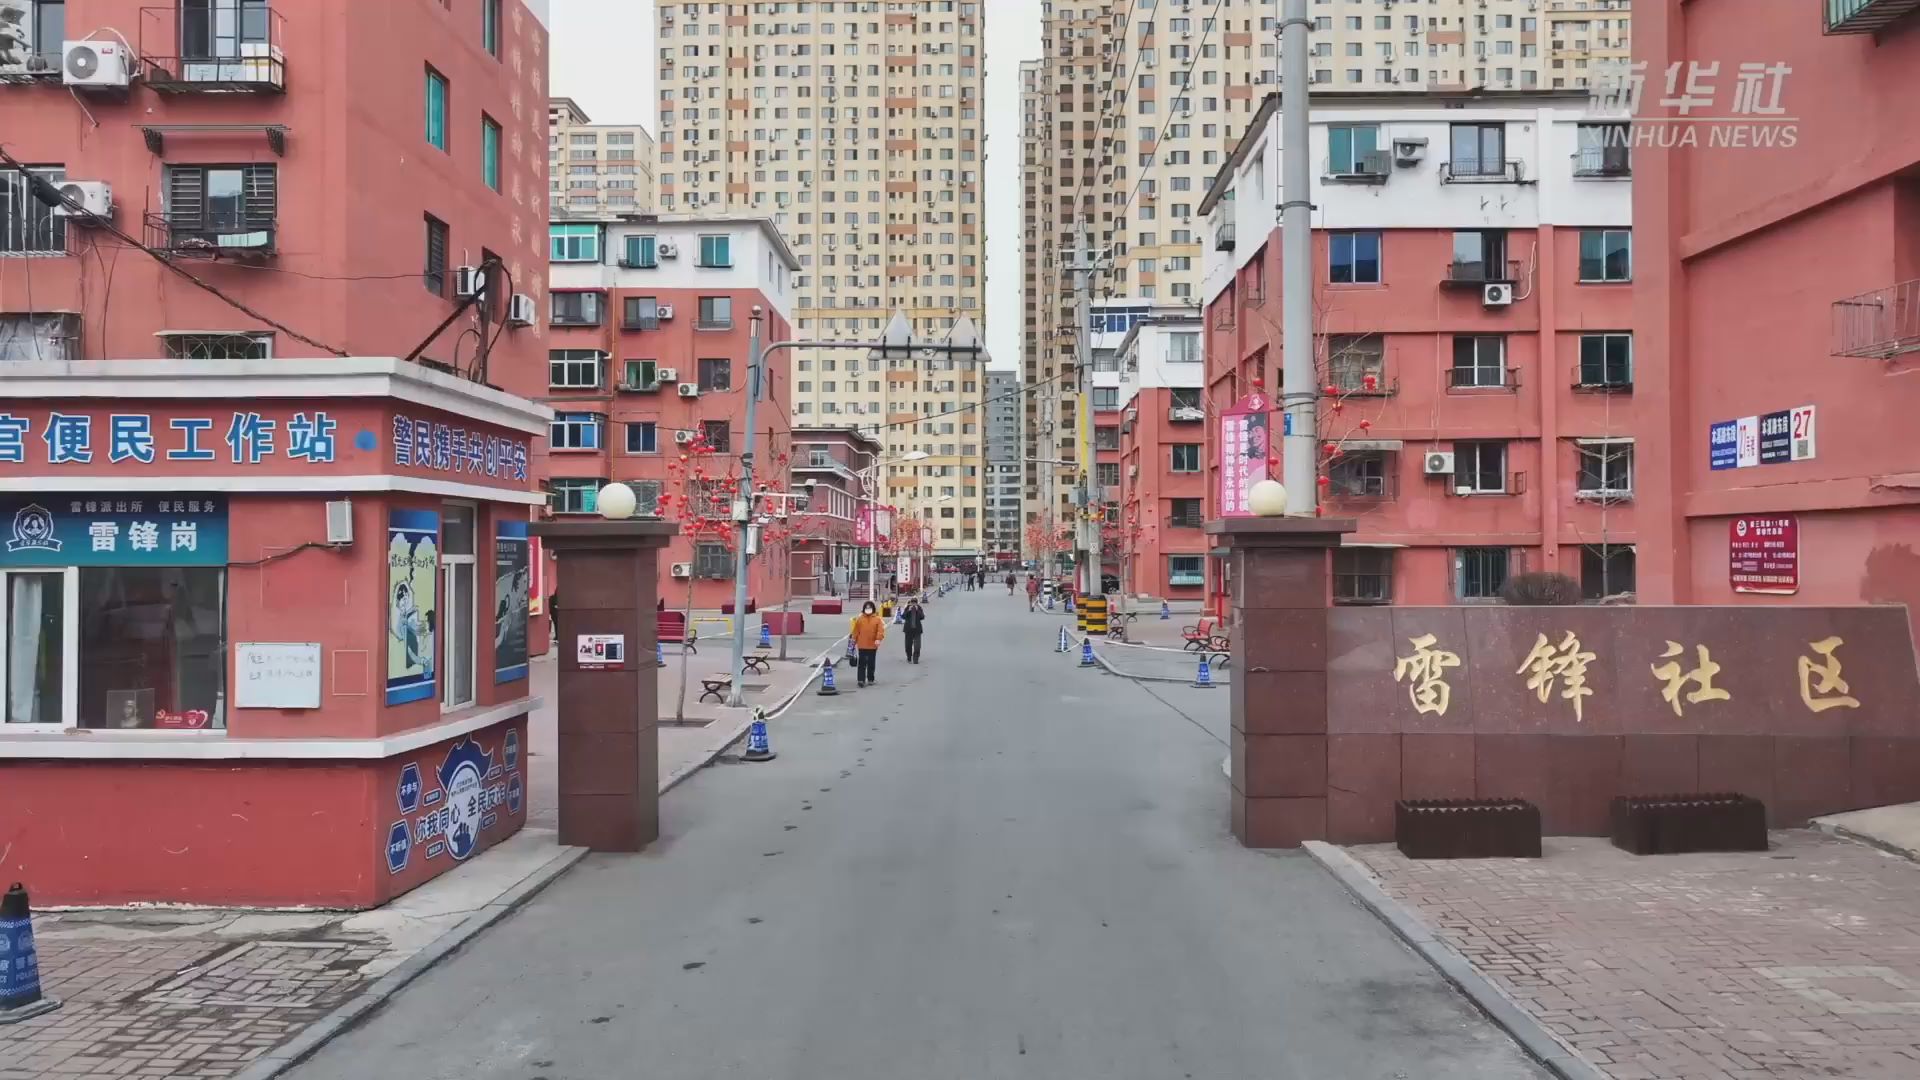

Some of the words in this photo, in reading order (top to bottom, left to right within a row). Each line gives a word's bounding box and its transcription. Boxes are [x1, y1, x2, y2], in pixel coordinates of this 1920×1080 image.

[0, 412, 338, 464] 官便民工作站
[392, 416, 528, 482] 警民携手共创平安
[1794, 410, 1811, 438] 27
[70, 501, 143, 513] 雷锋派出所
[158, 501, 216, 513] 便民服务
[89, 520, 198, 552] 雷锋岗
[1393, 630, 1861, 722] 雷锋社区
[416, 804, 460, 843] 你我同心
[468, 782, 506, 818] 全民反诈
